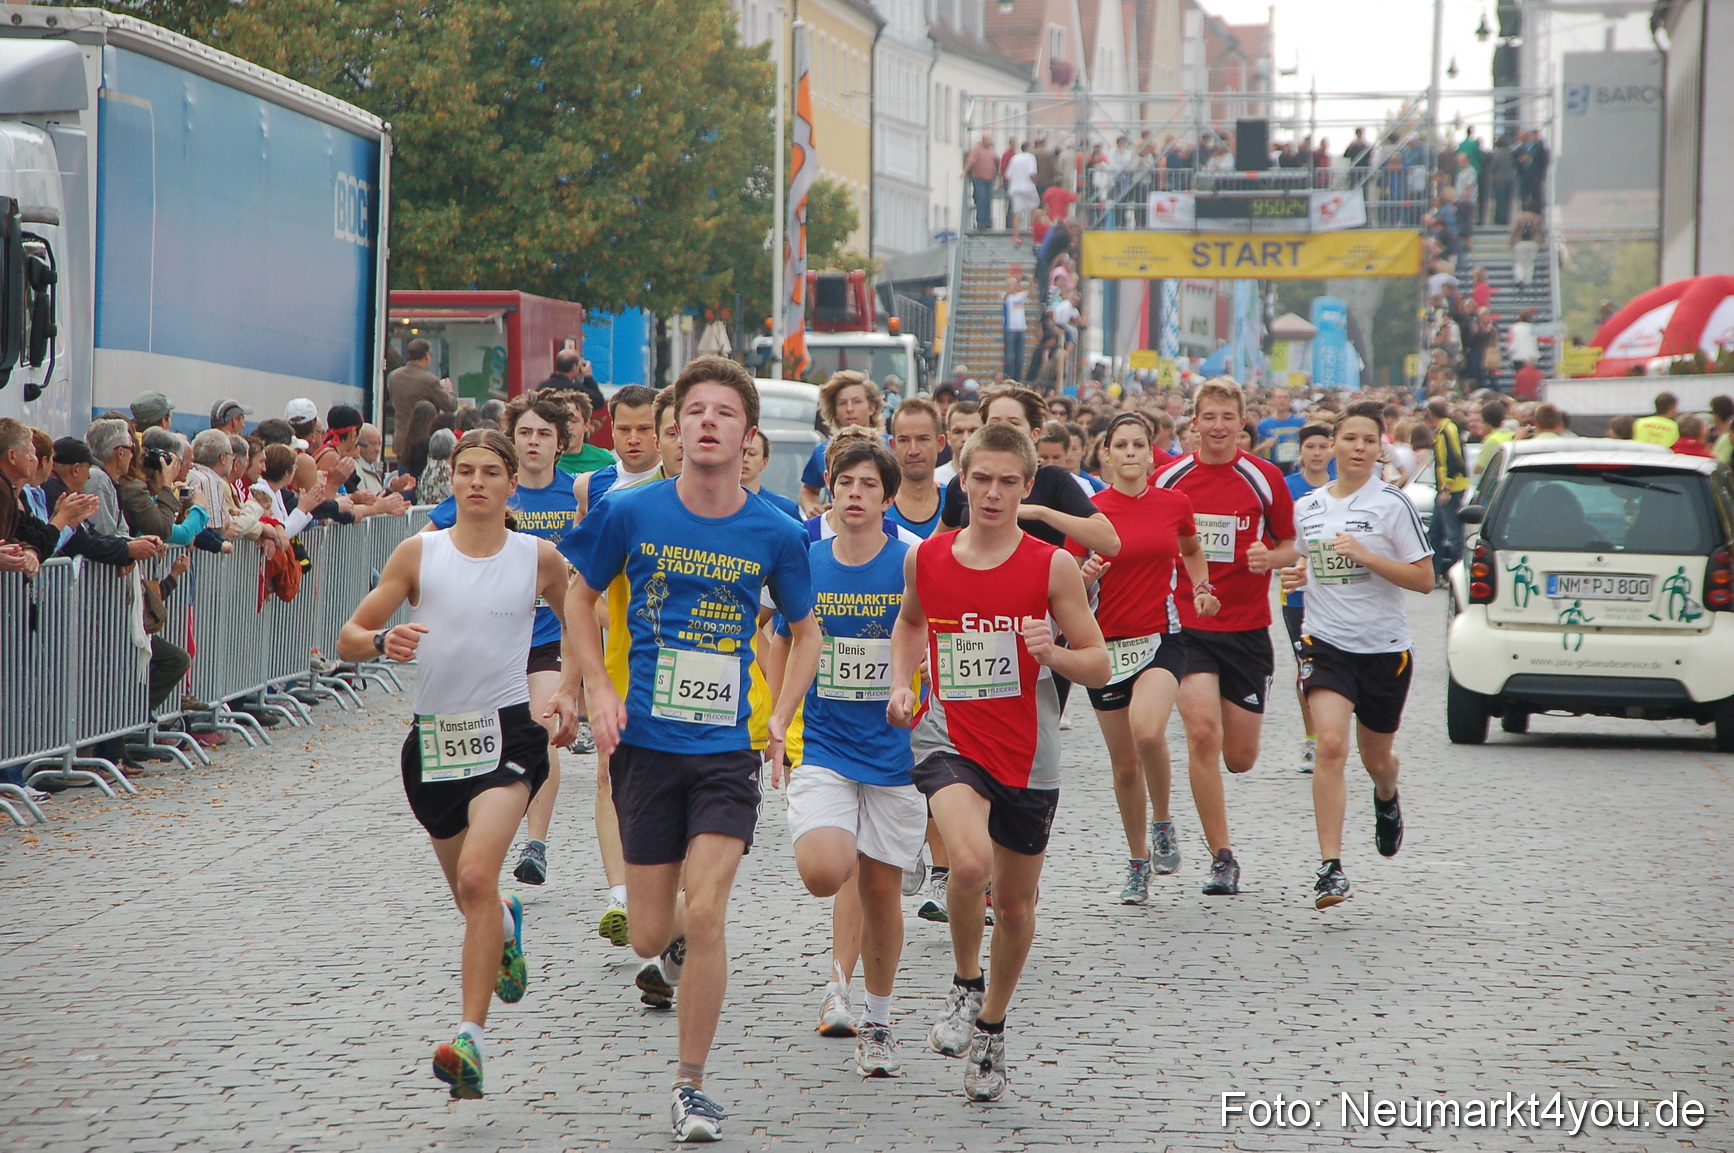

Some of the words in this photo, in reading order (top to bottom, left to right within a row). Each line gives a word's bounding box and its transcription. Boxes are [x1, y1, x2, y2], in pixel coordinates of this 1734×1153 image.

[1192, 241, 1306, 267] START
[640, 542, 659, 556] 10.
[662, 545, 761, 576] NEUMARKTER
[656, 558, 741, 584] STADTLAUF
[1559, 577, 1581, 592] NM
[1593, 578, 1614, 593] PJ
[1618, 579, 1650, 595] 800
[817, 592, 903, 605] NEUMARKTER
[814, 604, 887, 617] STADTLAUF
[688, 619, 742, 635] 20.09.2009
[838, 642, 866, 656] Denis
[956, 638, 984, 654] Björn
[1116, 637, 1150, 649] Vanessa
[820, 658, 826, 668] S
[839, 662, 889, 680] 5127
[940, 658, 946, 668] S
[960, 656, 1012, 678] 5172
[658, 674, 665, 685] S
[678, 679, 732, 702] 5254
[440, 716, 495, 733] Konstantin
[424, 739, 430, 750] S
[445, 735, 495, 758] 5186
